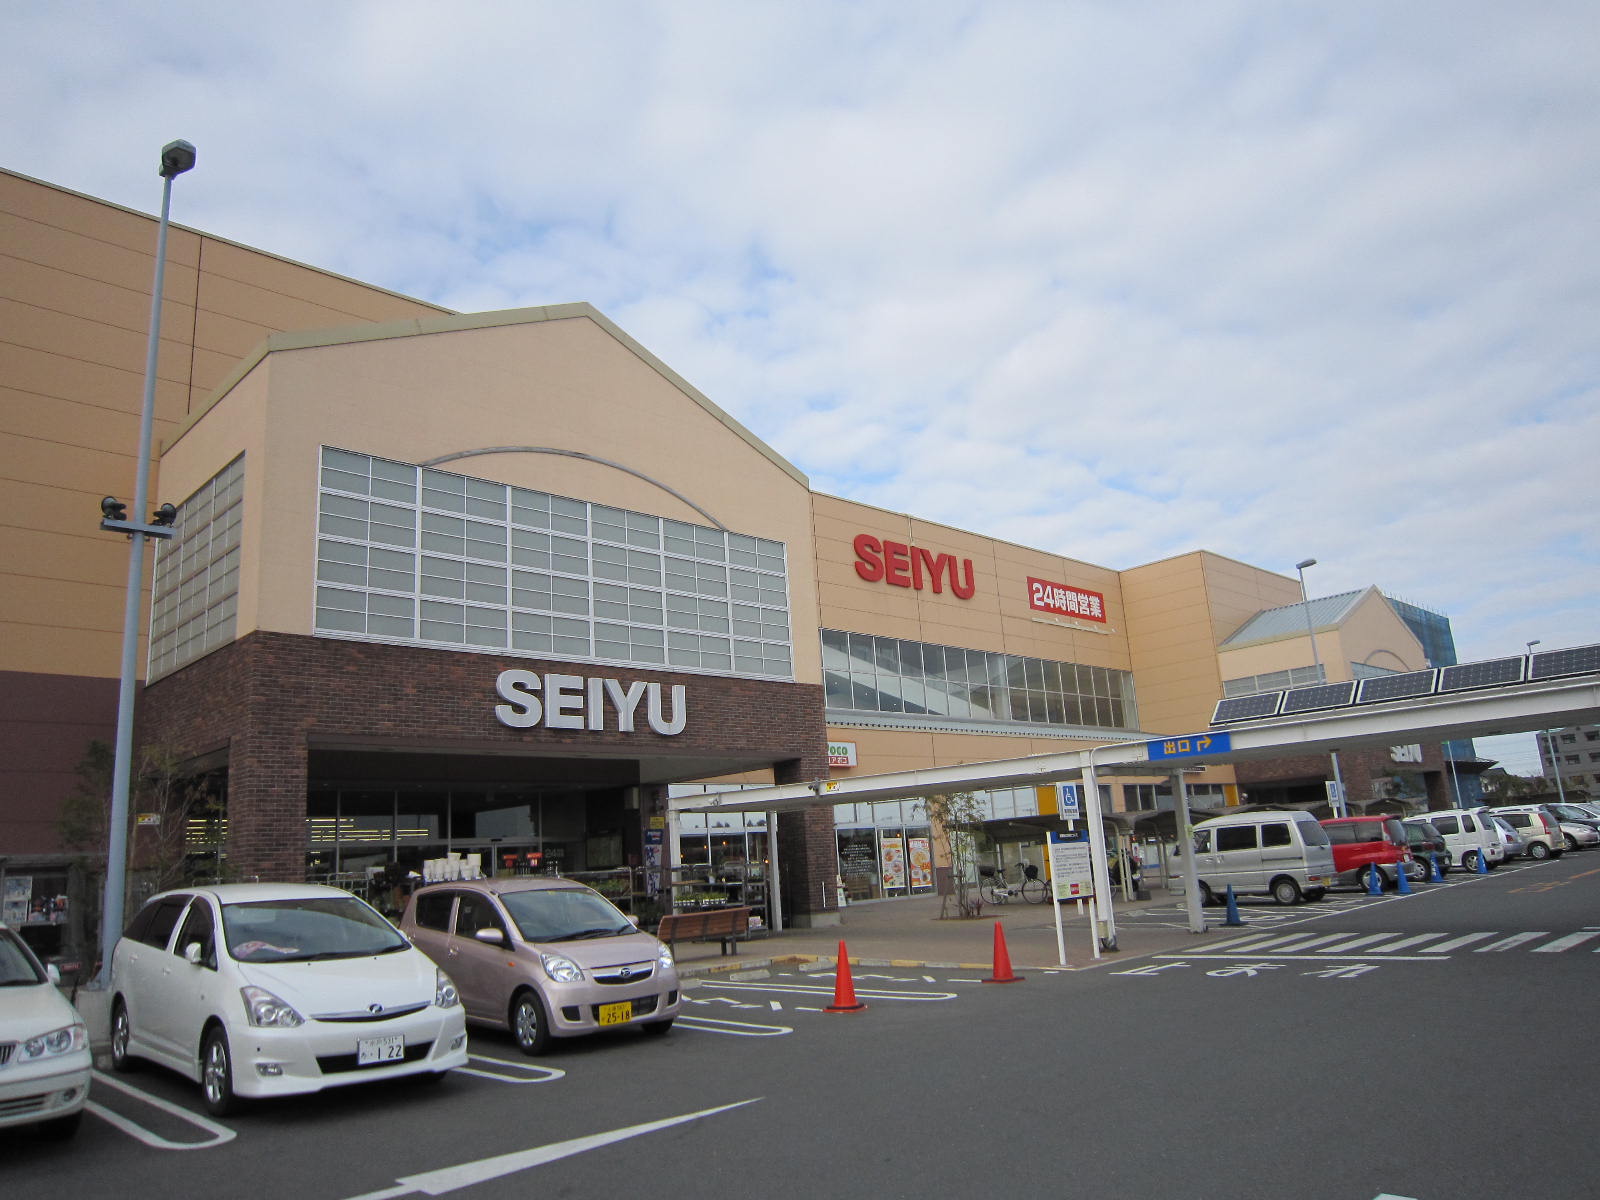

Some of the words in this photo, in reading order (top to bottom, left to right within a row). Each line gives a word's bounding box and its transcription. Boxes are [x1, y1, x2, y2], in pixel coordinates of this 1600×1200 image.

[853, 533, 975, 600] SEIYU
[1032, 583, 1102, 618] 24時間営業
[495, 669, 687, 736] SEIYU
[1164, 739, 1190, 754] 出口
